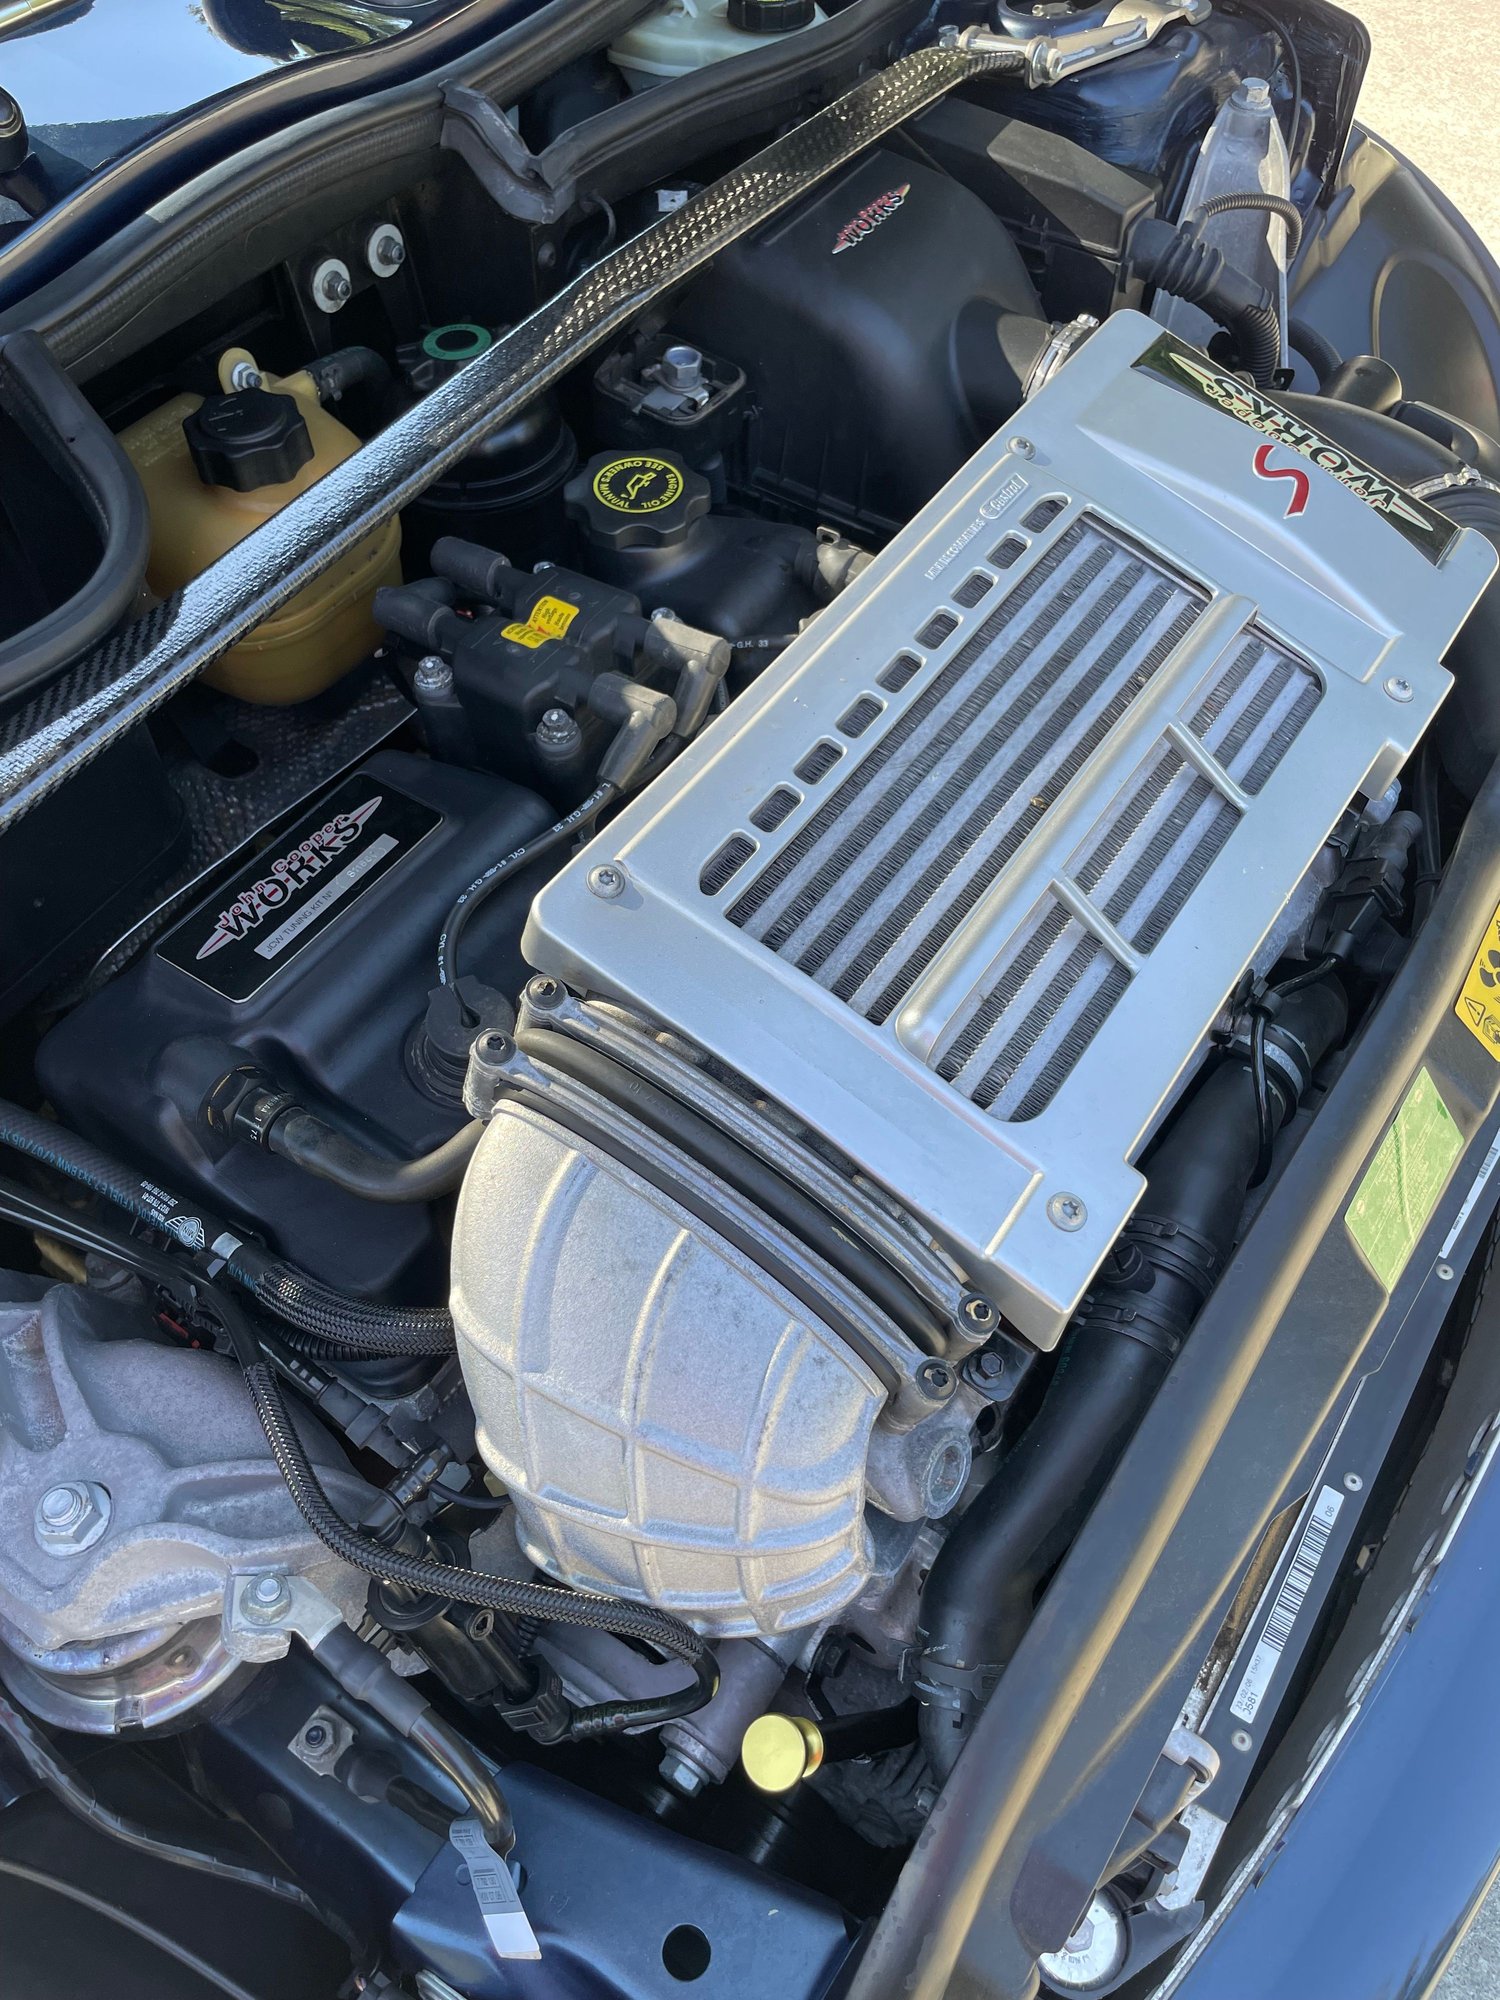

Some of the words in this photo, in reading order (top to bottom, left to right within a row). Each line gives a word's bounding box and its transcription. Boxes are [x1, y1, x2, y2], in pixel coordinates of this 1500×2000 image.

[843, 194, 904, 245] WORKS
[1213, 377, 1398, 510] WORKS
[644, 461, 665, 472] SEE
[660, 474, 678, 502] ENGINE
[1252, 444, 1310, 519] S
[600, 483, 630, 509] MANUAL
[641, 499, 661, 509] OIL
[990, 480, 1022, 511] Castrol
[758, 640, 769, 648] 33
[552, 823, 564, 832] 33
[508, 848, 526, 859] CYL
[220, 882, 264, 927] John
[273, 815, 345, 873] Cooper
[225, 821, 361, 938] WORKS
[457, 894, 468, 904] 33
[266, 932, 284, 953] JCW
[283, 908, 313, 937] TUNING
[310, 898, 325, 914] KIT
[438, 933, 446, 950] CYL
[1324, 1505, 1335, 1518] 06
